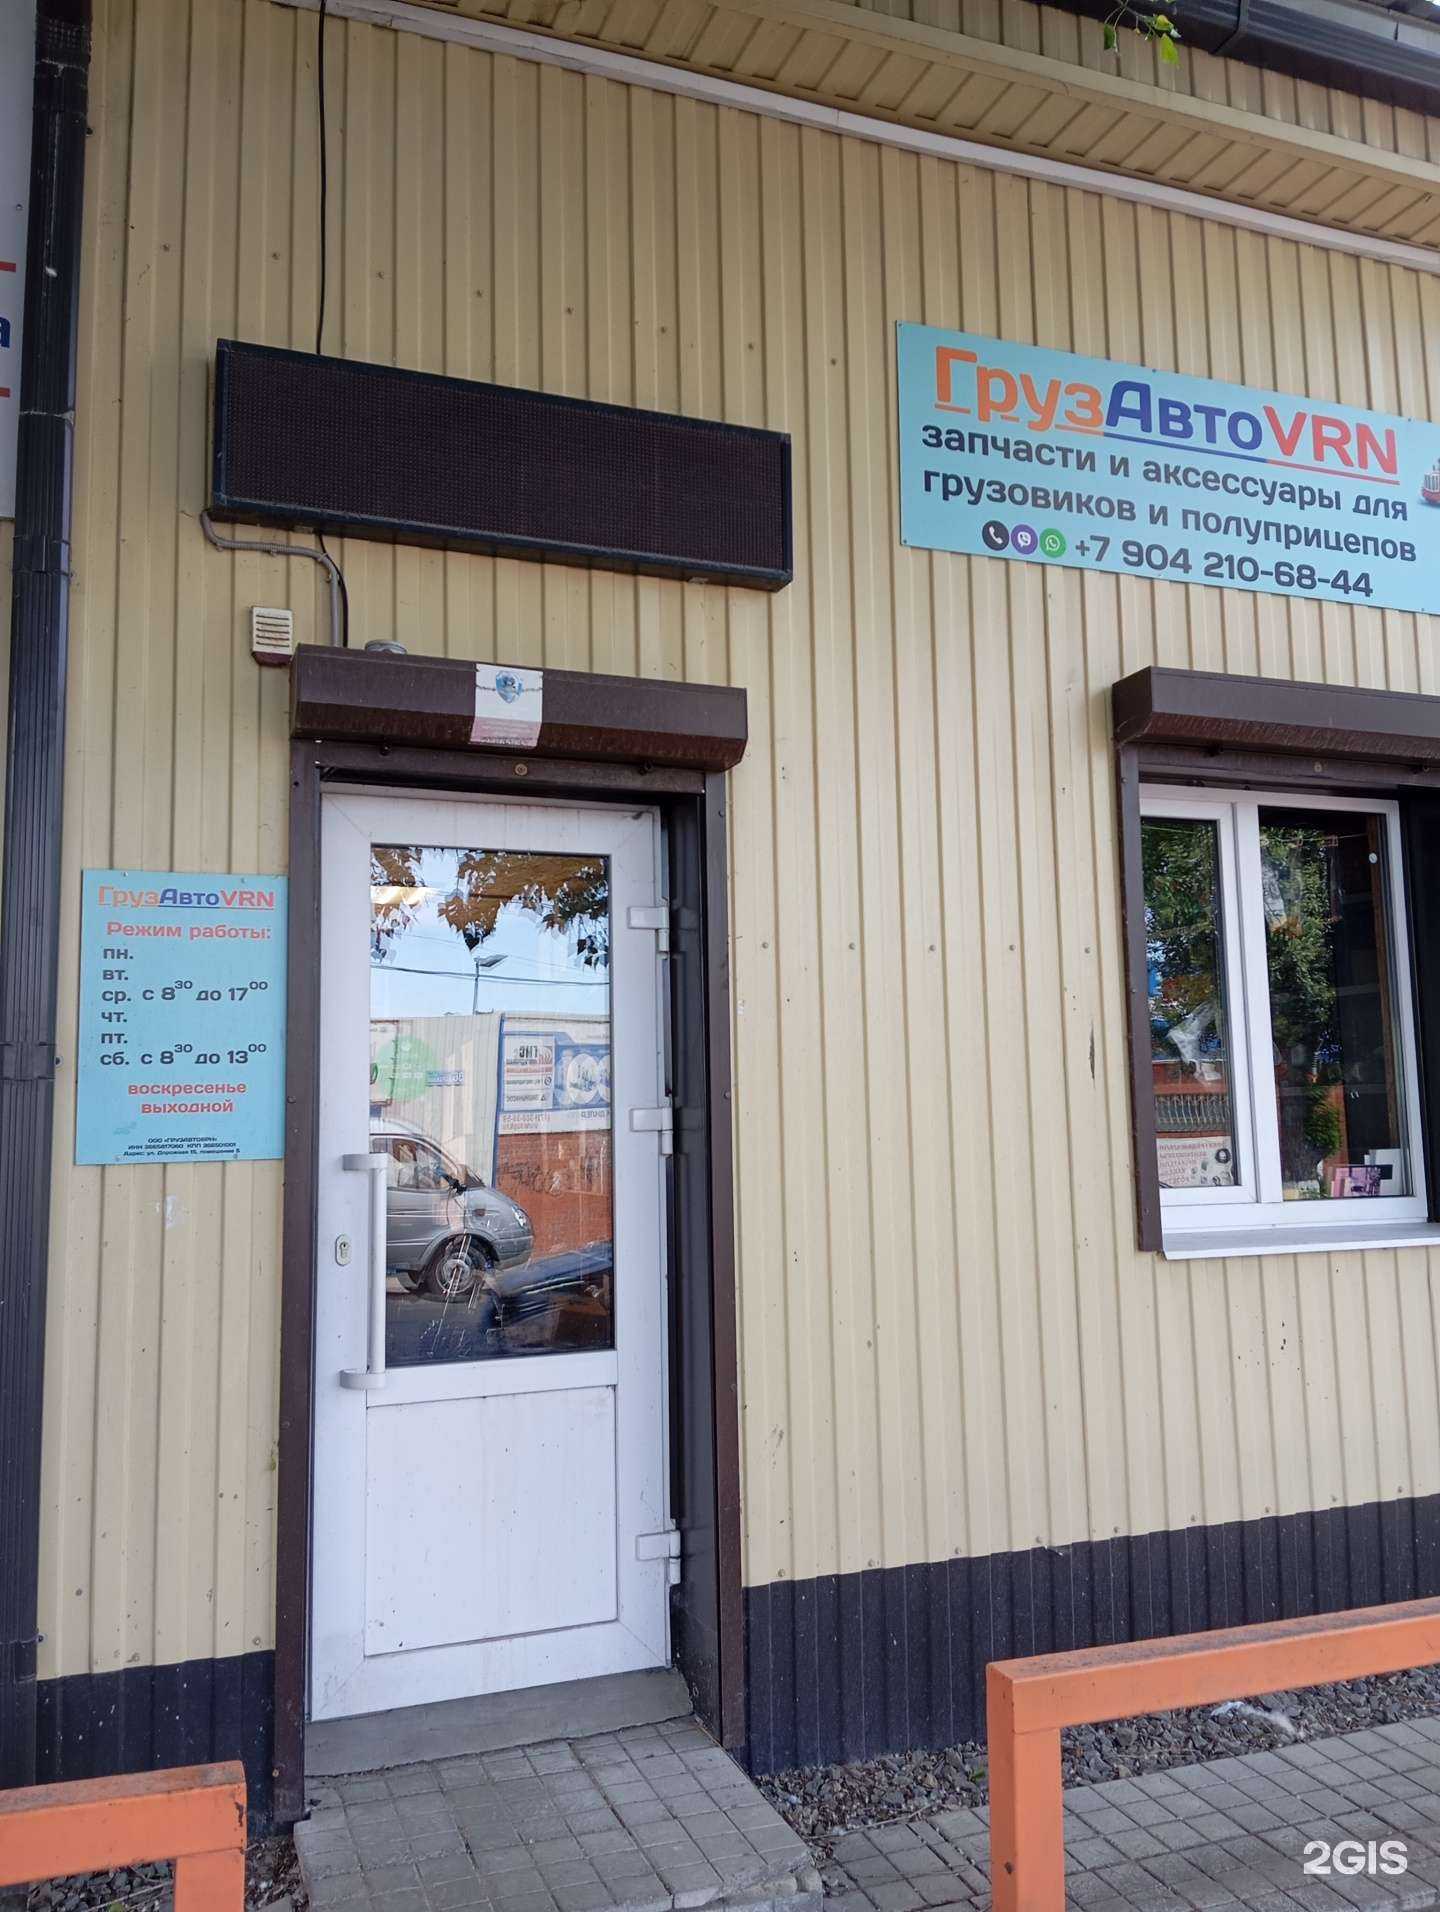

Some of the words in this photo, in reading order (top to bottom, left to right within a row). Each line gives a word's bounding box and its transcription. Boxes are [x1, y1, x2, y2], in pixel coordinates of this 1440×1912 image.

[935, 346, 1399, 475] ГрузАвтоVRN
[922, 424, 1096, 472] запчасти
[1110, 455, 1130, 478] и
[1143, 459, 1341, 511] аксессуары
[1353, 496, 1408, 521] для
[923, 469, 1136, 521] грузовиков
[1148, 504, 1169, 526] и
[1182, 507, 1417, 562] полуприцепов
[1075, 536, 1110, 562] +7
[1122, 540, 1192, 574] 904
[1203, 552, 1373, 597] 210-68-44
[107, 922, 181, 937] Режим
[189, 924, 271, 940] работы:
[103, 948, 134, 960] пн.
[102, 969, 129, 981] вт.
[101, 989, 131, 1004] ср.
[142, 989, 155, 1001] с
[195, 989, 222, 1001] до
[101, 1011, 127, 1023] чт.
[101, 1033, 128, 1044] пт.
[100, 1051, 130, 1065] сб.
[140, 1053, 153, 1065] с
[194, 1053, 221, 1064] до
[128, 1083, 247, 1096] воскресенье
[141, 1099, 233, 1114] выходной
